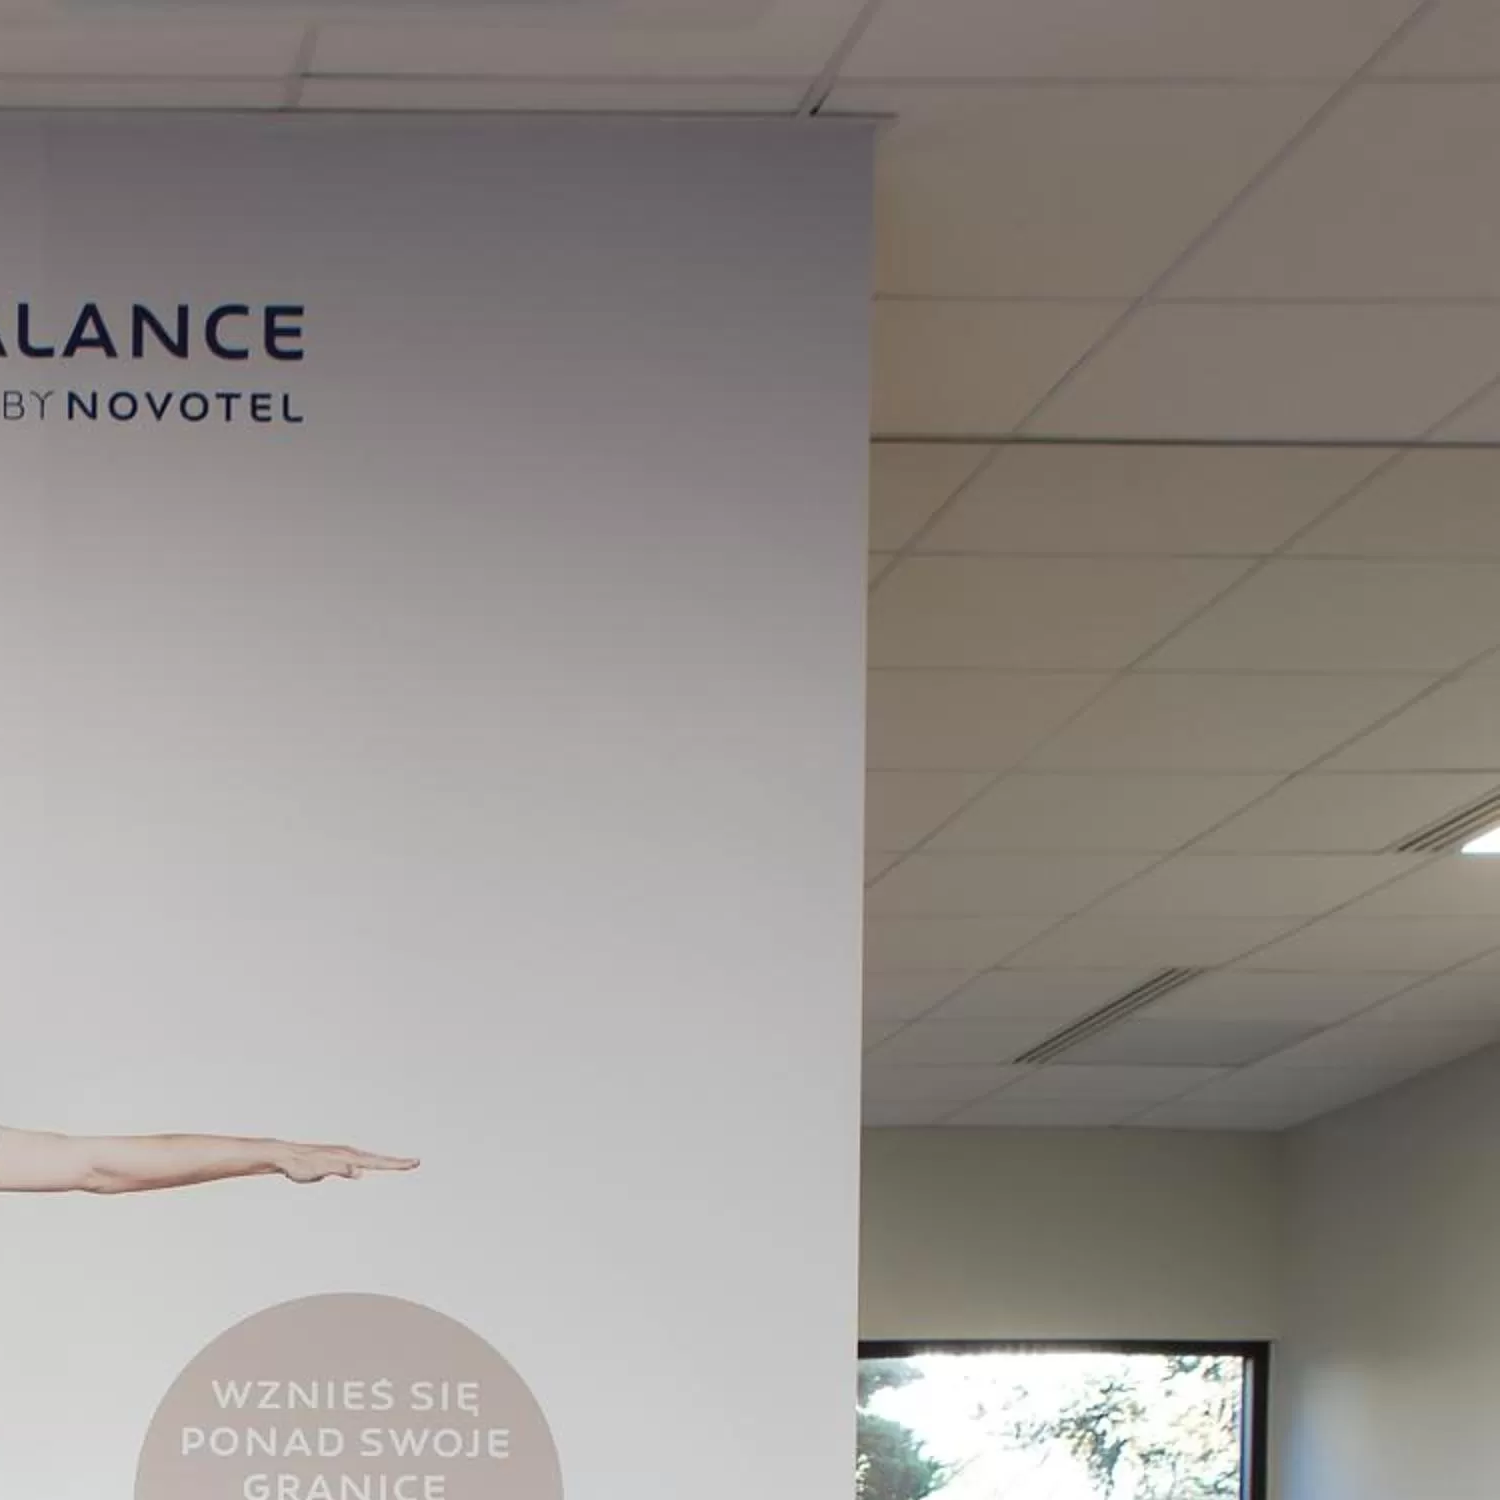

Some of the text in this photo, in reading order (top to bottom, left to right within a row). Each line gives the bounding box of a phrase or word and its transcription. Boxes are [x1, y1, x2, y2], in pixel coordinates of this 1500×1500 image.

[3, 390, 304, 423] BY NOVOTEL
[211, 1377, 481, 1417] WZNIEŚ SIĘ
[181, 1426, 511, 1460] PONAD SWOJE
